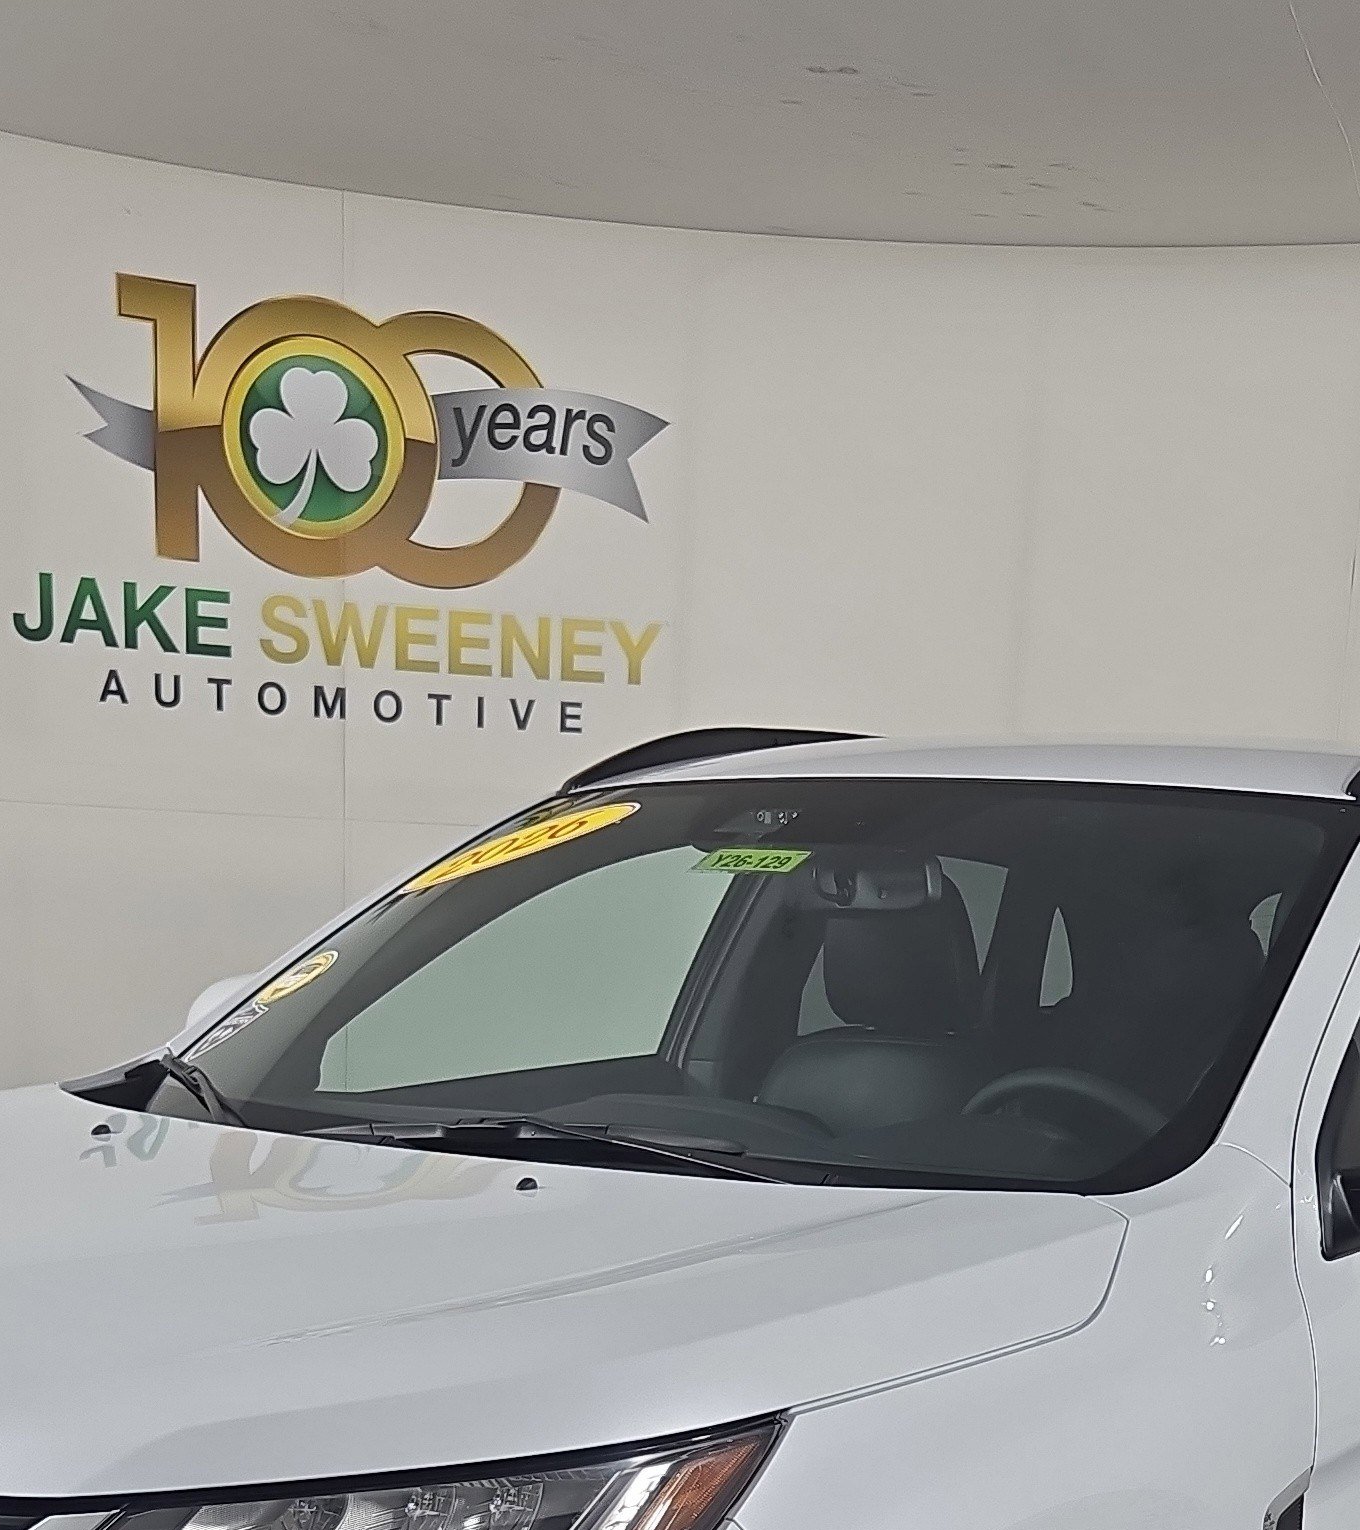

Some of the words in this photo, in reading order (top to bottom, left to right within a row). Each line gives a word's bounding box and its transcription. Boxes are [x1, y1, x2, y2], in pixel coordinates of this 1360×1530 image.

[115, 272, 564, 589] 100
[451, 402, 616, 467] years
[13, 572, 232, 658] JAKE
[259, 595, 664, 685] SWEENEY
[100, 669, 583, 734] AUTOMOTIVE
